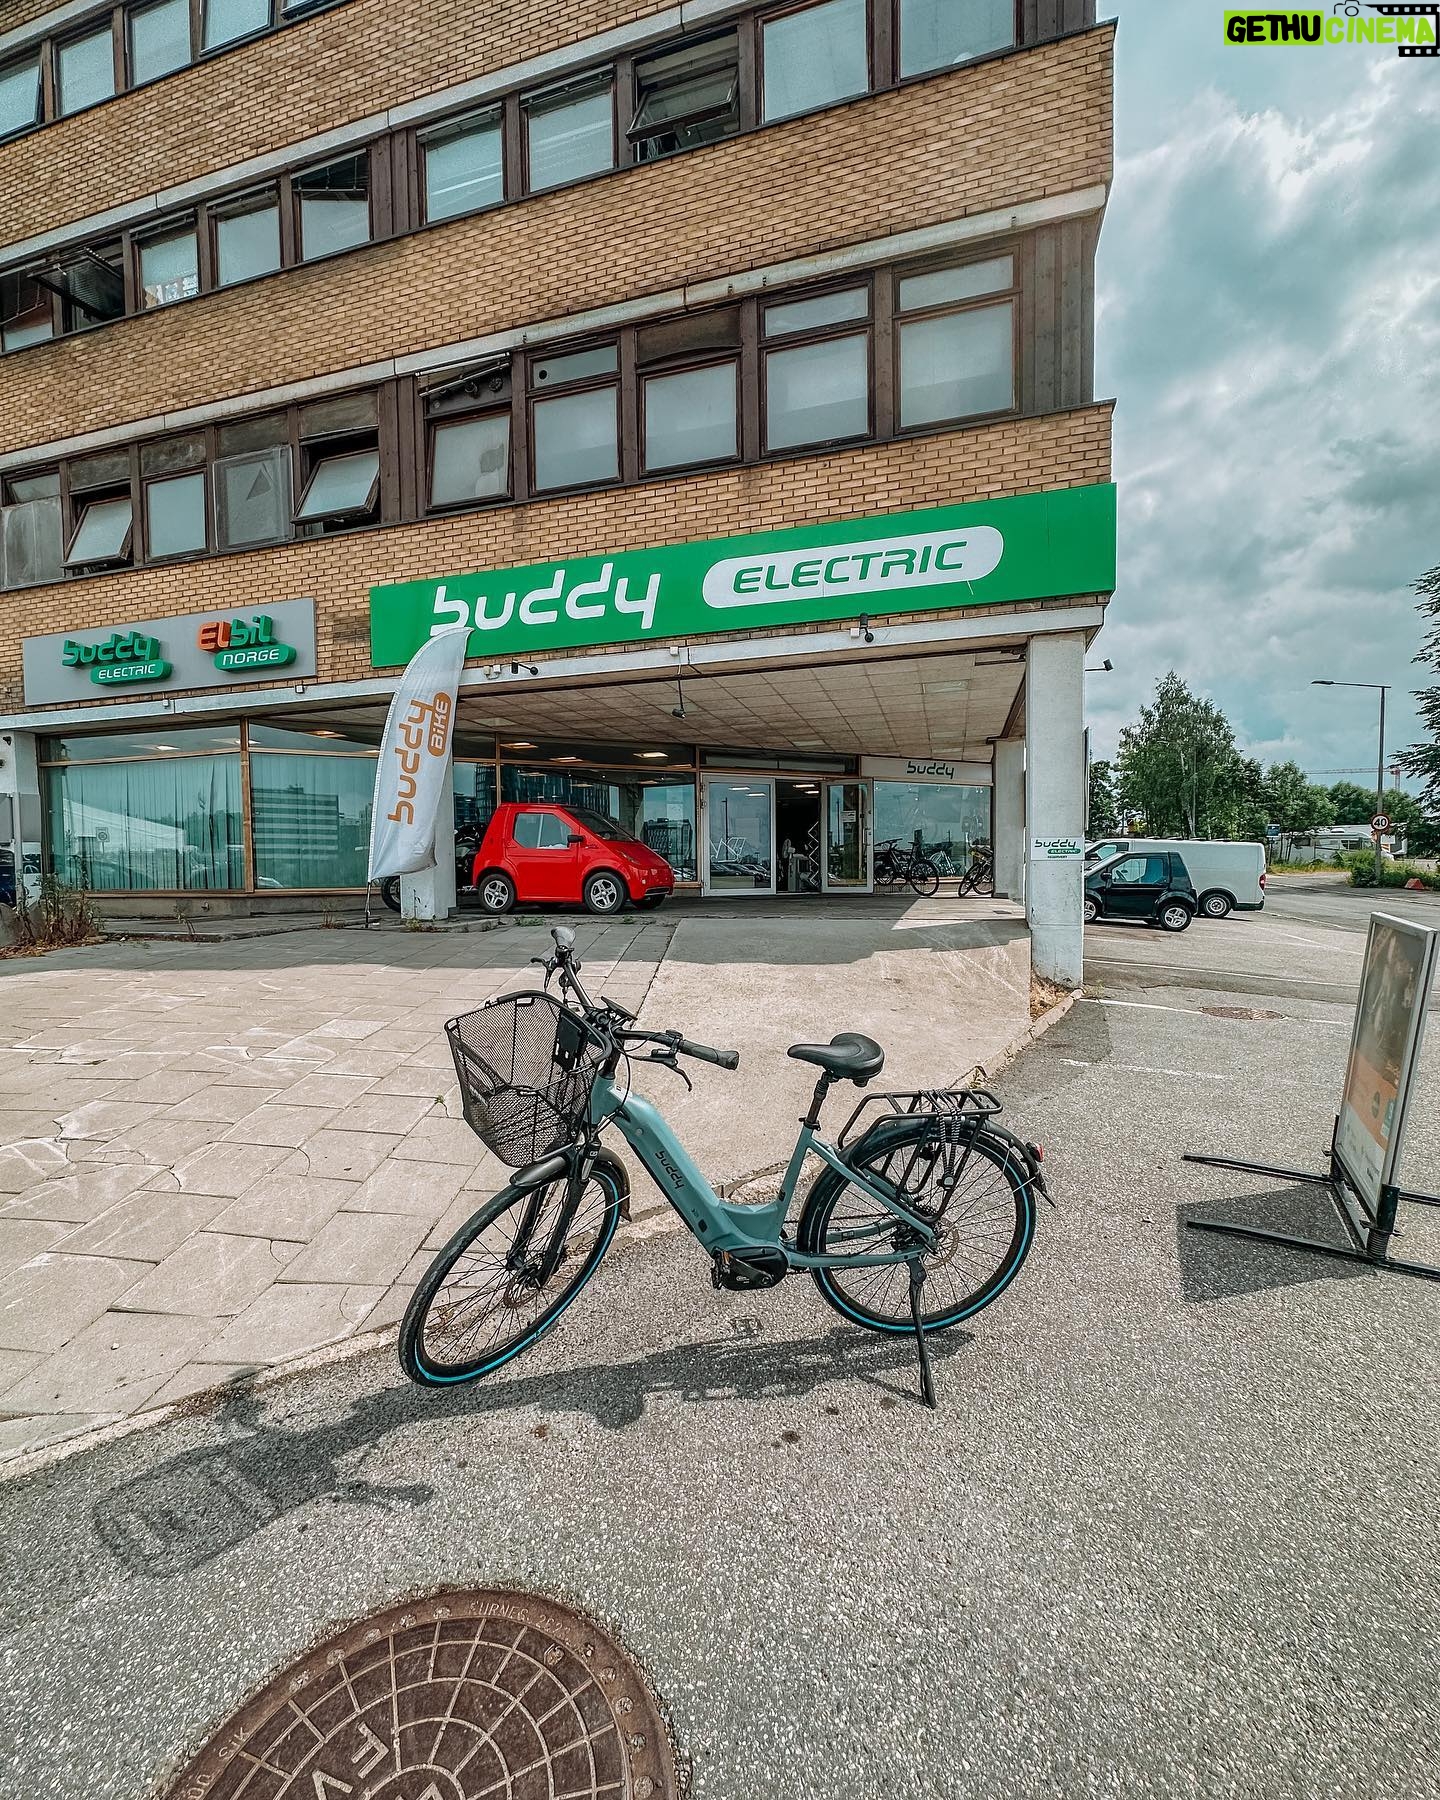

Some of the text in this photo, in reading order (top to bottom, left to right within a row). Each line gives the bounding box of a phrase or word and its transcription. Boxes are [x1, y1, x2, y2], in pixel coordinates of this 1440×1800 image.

[430, 540, 968, 636] buddy ELECTRIC
[62, 631, 160, 667] buddy
[222, 648, 281, 666] NORGE
[98, 663, 156, 680] ELECTRIC
[387, 699, 434, 825] buddy
[906, 760, 955, 780] buddy
[1373, 818, 1387, 827] 40
[1034, 838, 1077, 849] buddy
[655, 1150, 685, 1190] buddy
